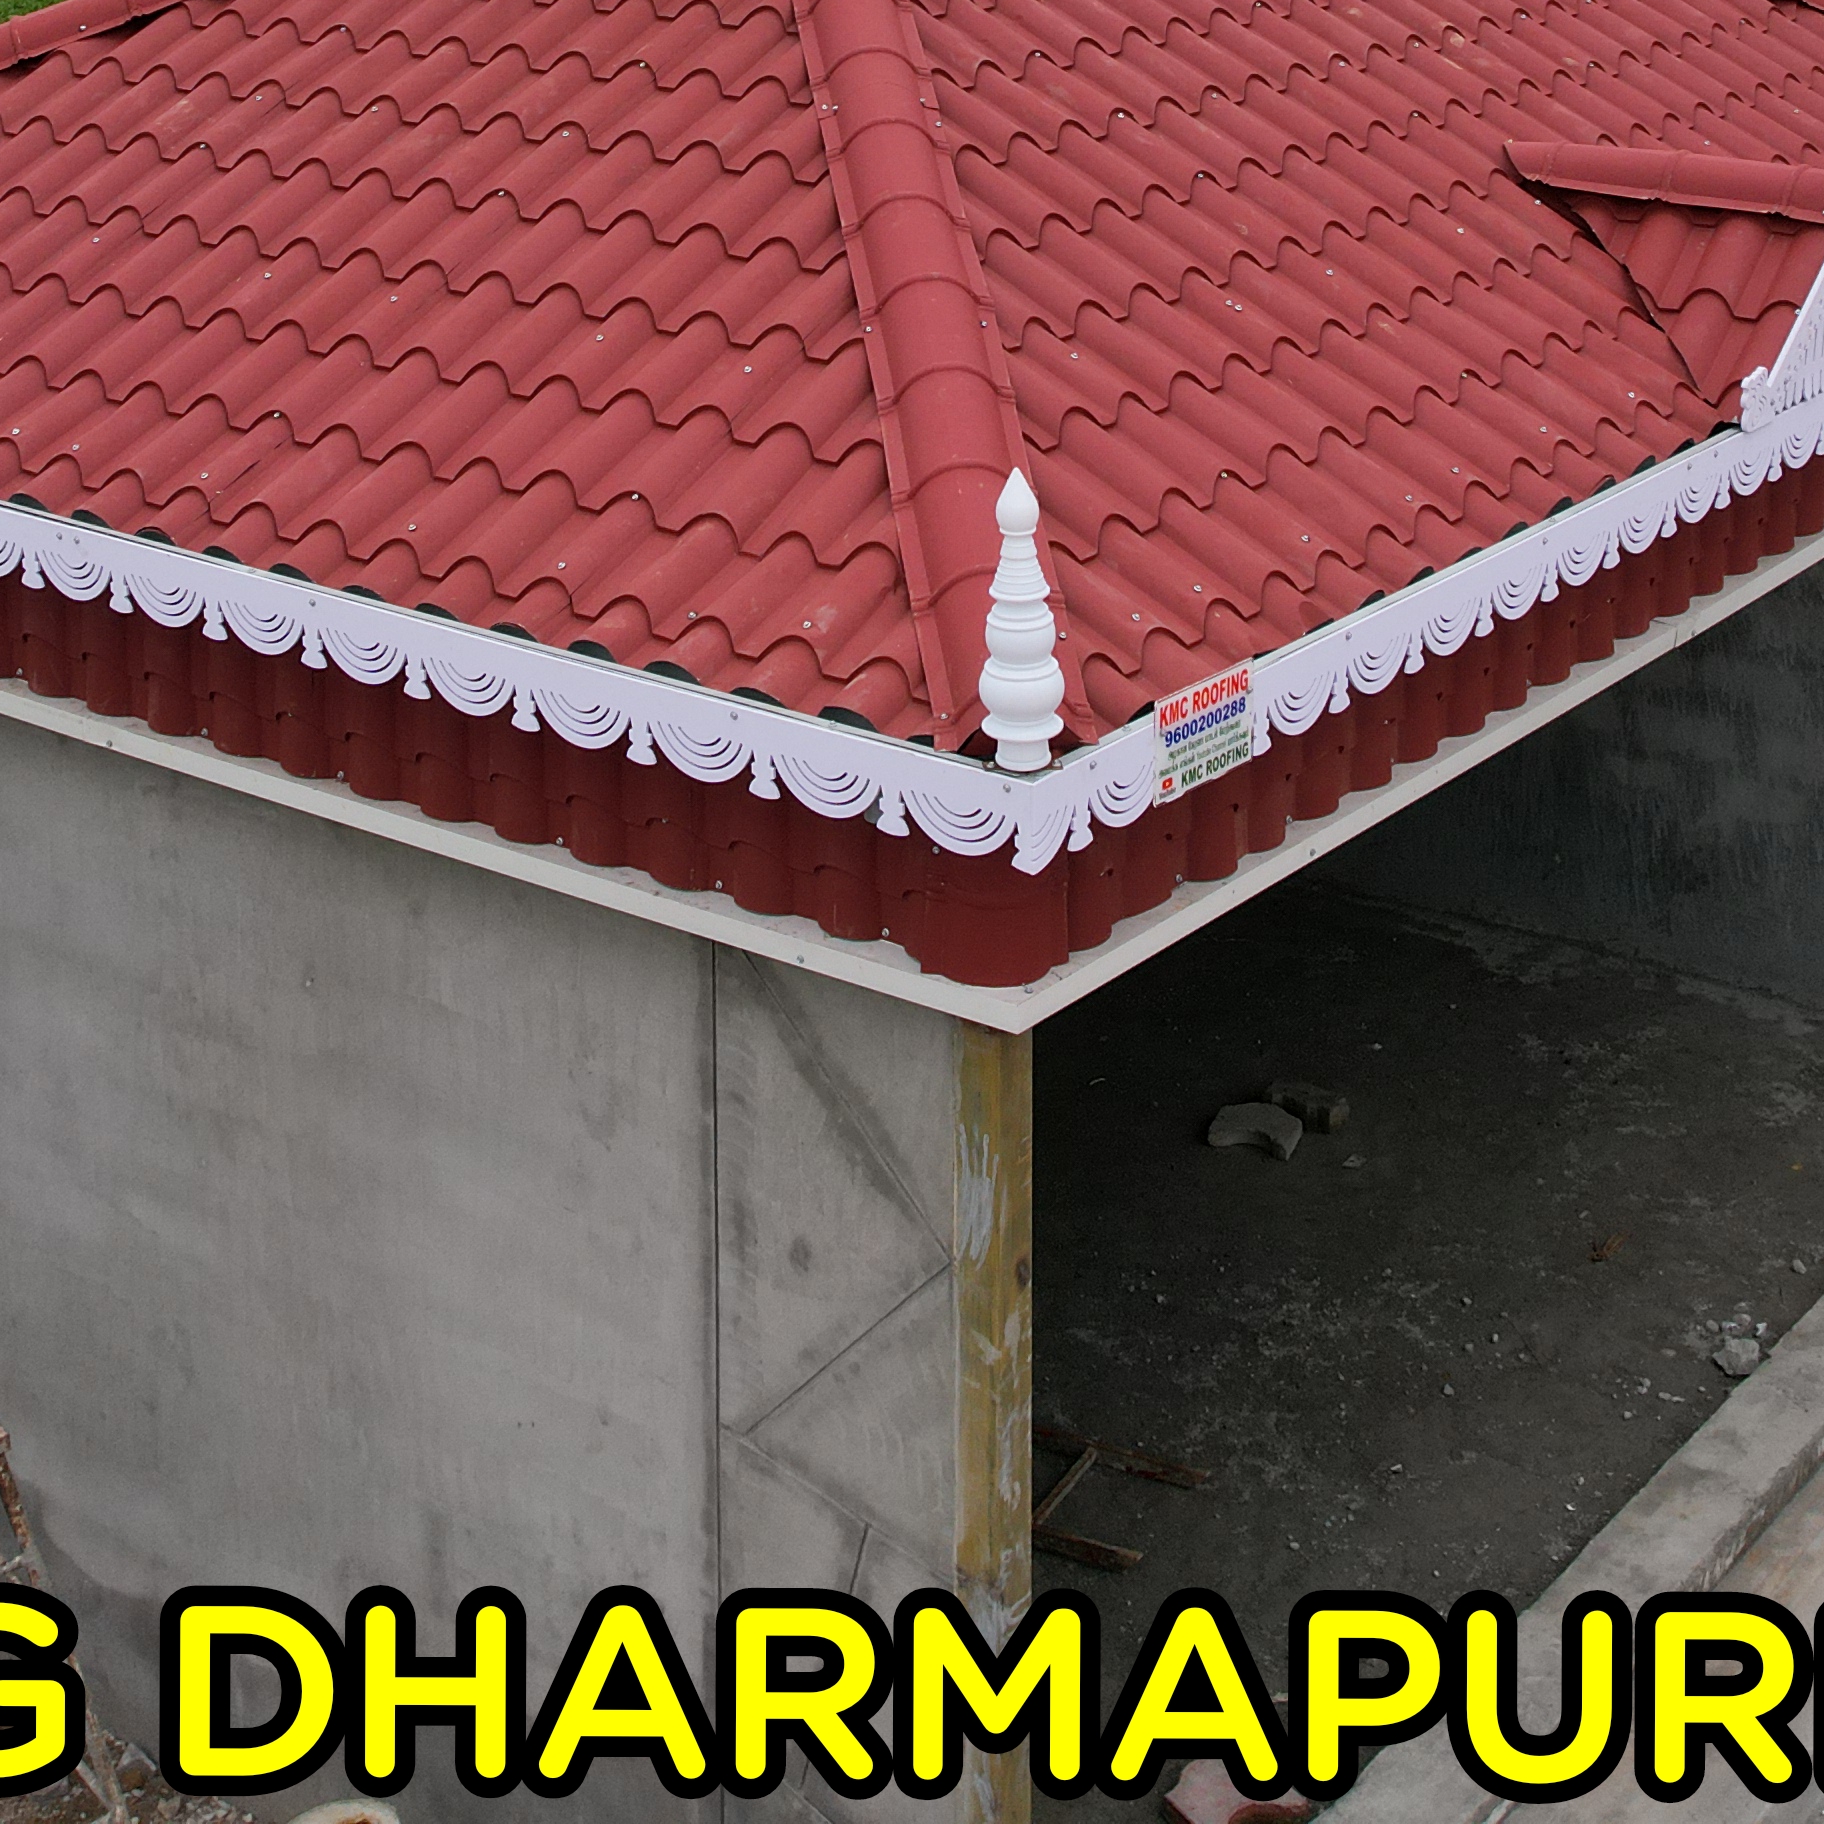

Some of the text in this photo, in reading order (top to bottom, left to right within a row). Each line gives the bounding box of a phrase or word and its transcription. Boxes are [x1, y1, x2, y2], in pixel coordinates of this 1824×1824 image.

[1159, 667, 1249, 729] KMC ROOFING
[1164, 696, 1246, 748] 9600200288
[1181, 763, 1204, 788] KMC
[1205, 741, 1249, 777] ROOFING
